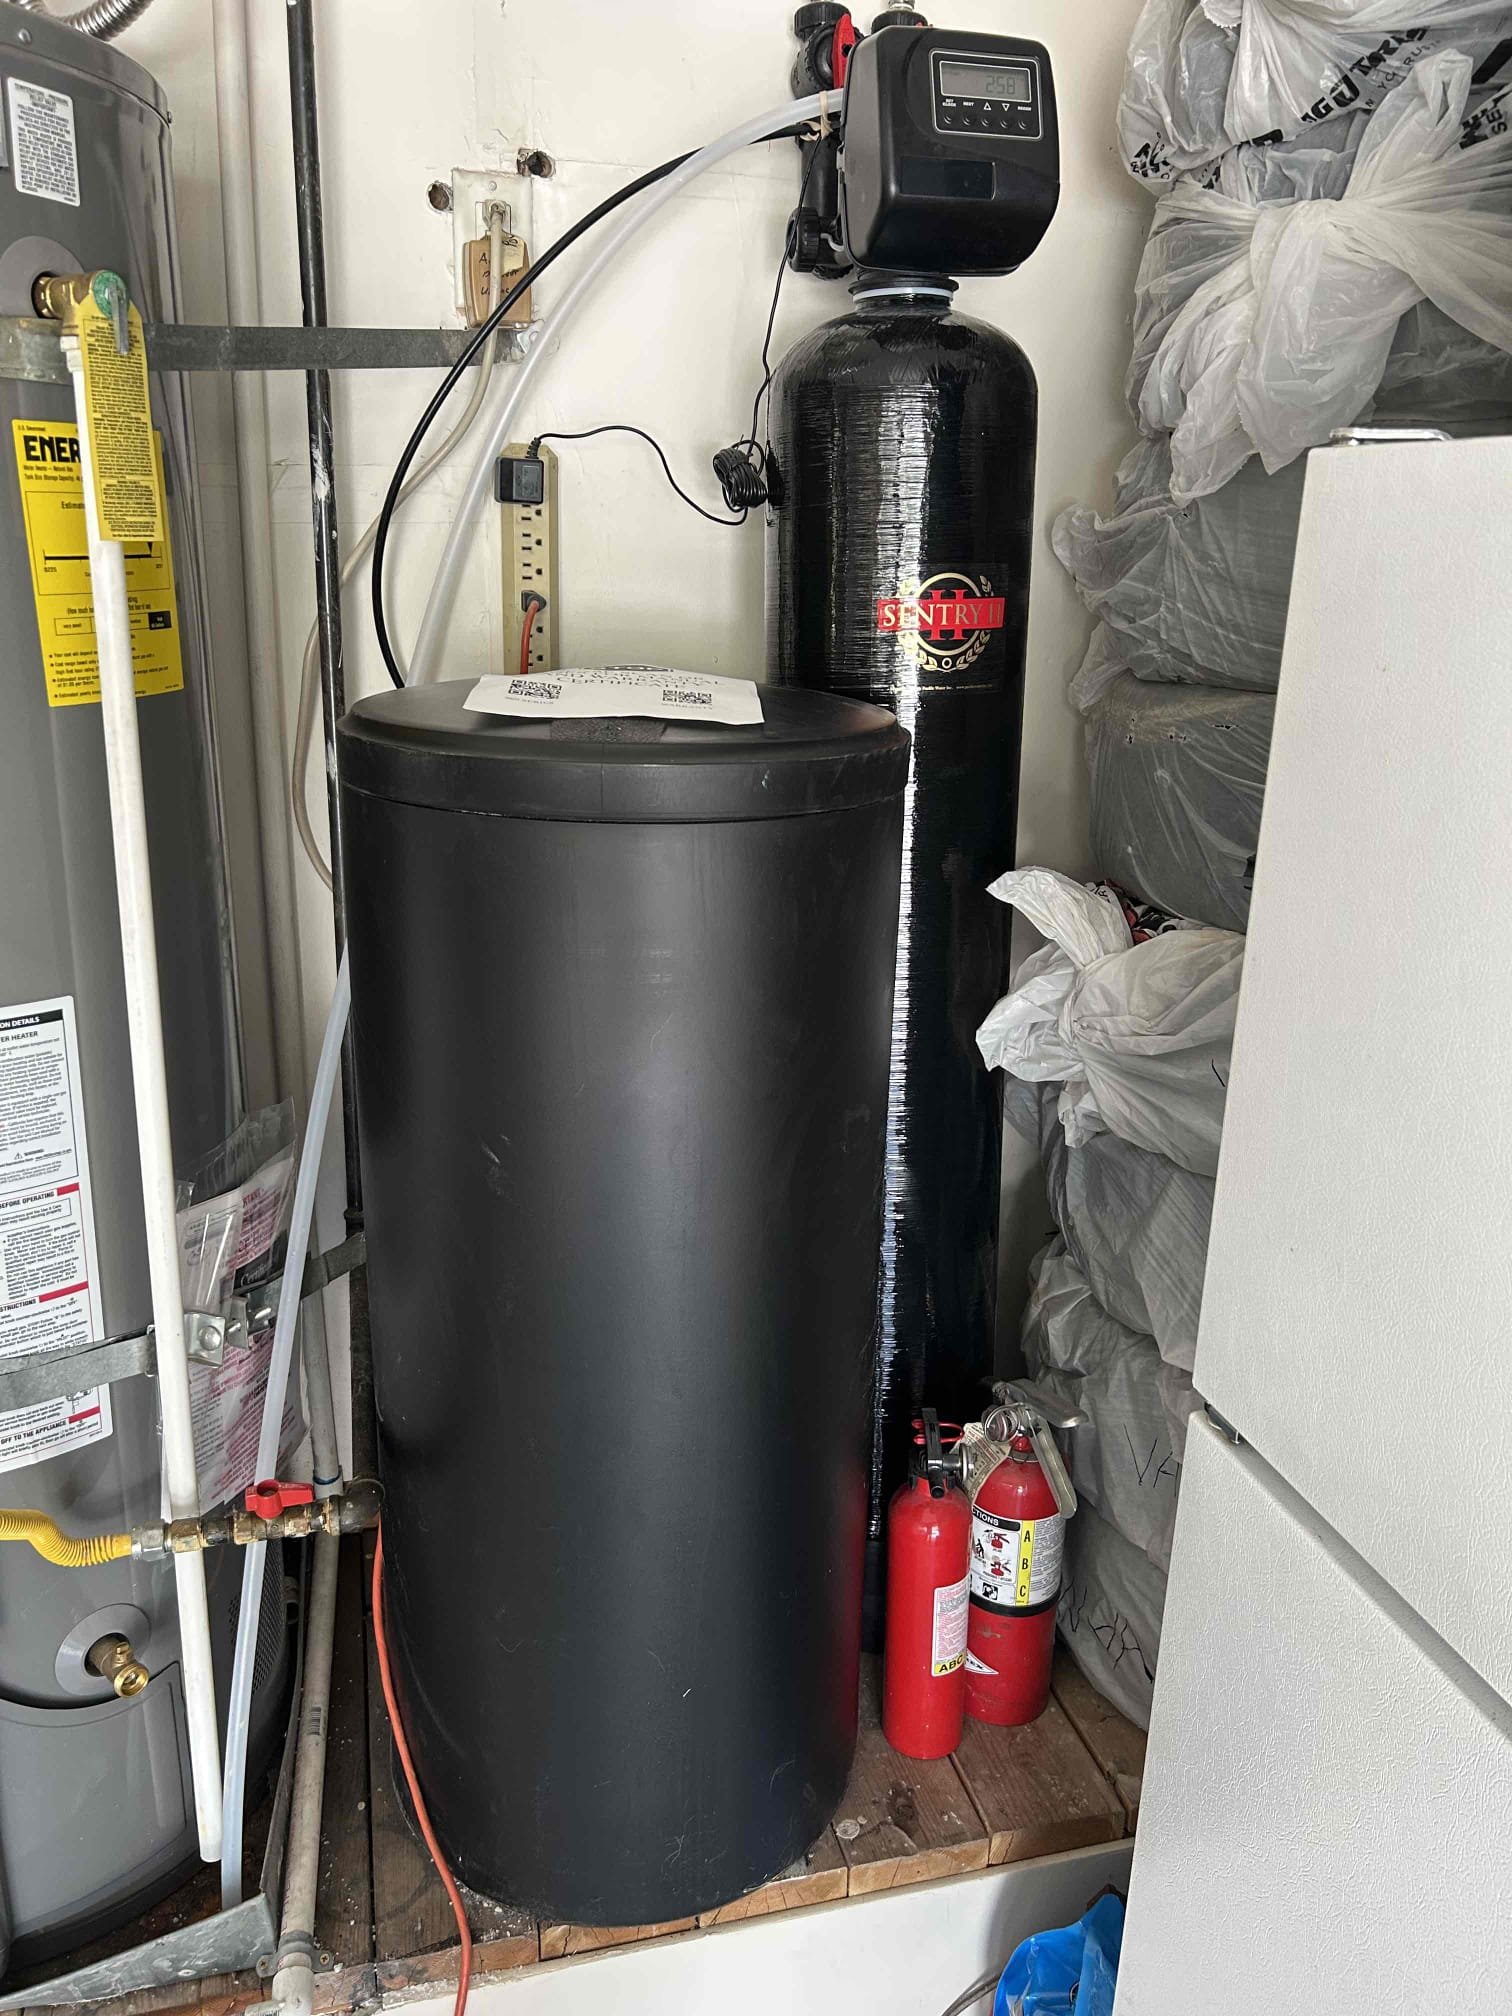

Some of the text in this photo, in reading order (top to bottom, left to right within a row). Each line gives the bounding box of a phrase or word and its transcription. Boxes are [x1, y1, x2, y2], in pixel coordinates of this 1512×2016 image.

[985, 75, 1016, 95] 2:58
[883, 602, 1001, 627] SENTRY II
[11, 1016, 40, 1027] DETAILS
[11, 1030, 38, 1041] HEATER
[22, 1192, 55, 1204] OPERATING
[0, 1437, 12, 1445] OFF
[23, 1431, 34, 1440] THE
[36, 1420, 67, 1435] APPLIANCE
[1020, 1530, 1031, 1597] A B C
